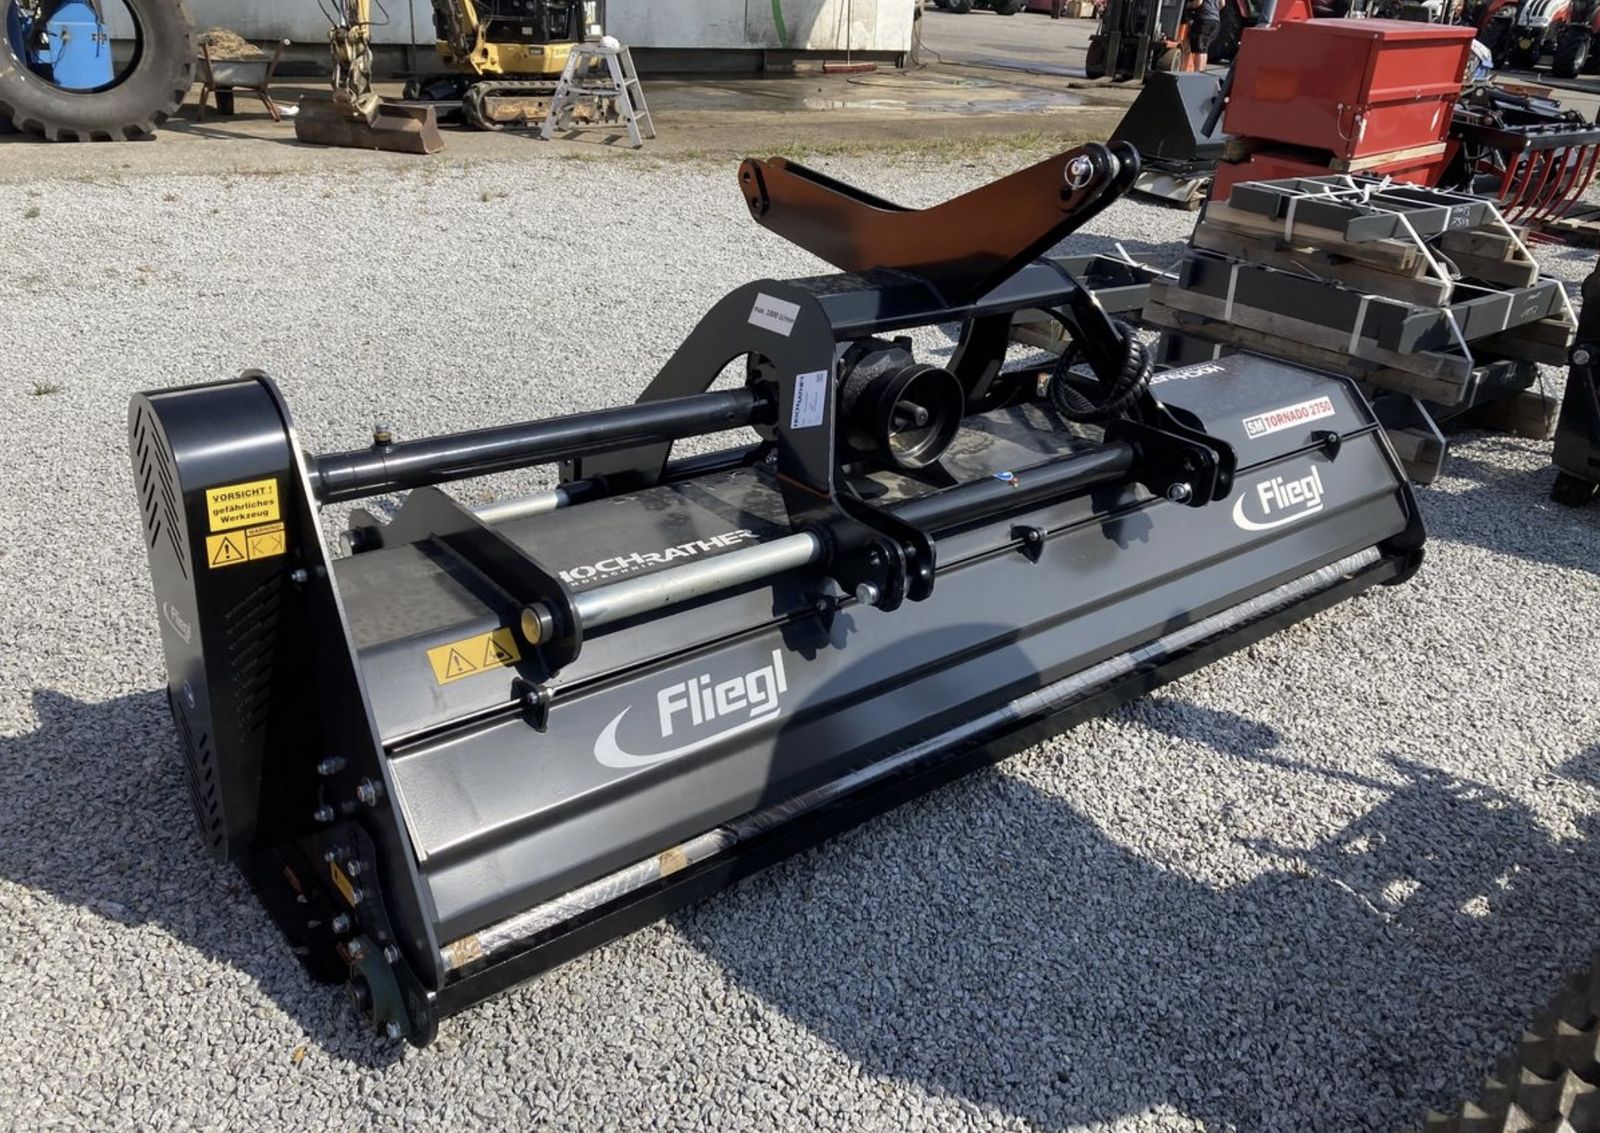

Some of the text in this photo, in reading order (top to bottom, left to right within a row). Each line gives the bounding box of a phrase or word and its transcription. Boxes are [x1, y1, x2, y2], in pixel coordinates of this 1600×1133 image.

[1246, 400, 1332, 436] SM TORNADO 2750
[212, 499, 275, 516] gefährliches
[1256, 464, 1324, 515] Fliegl
[220, 510, 270, 523] Werkzeug
[657, 648, 788, 738] Fliegl
